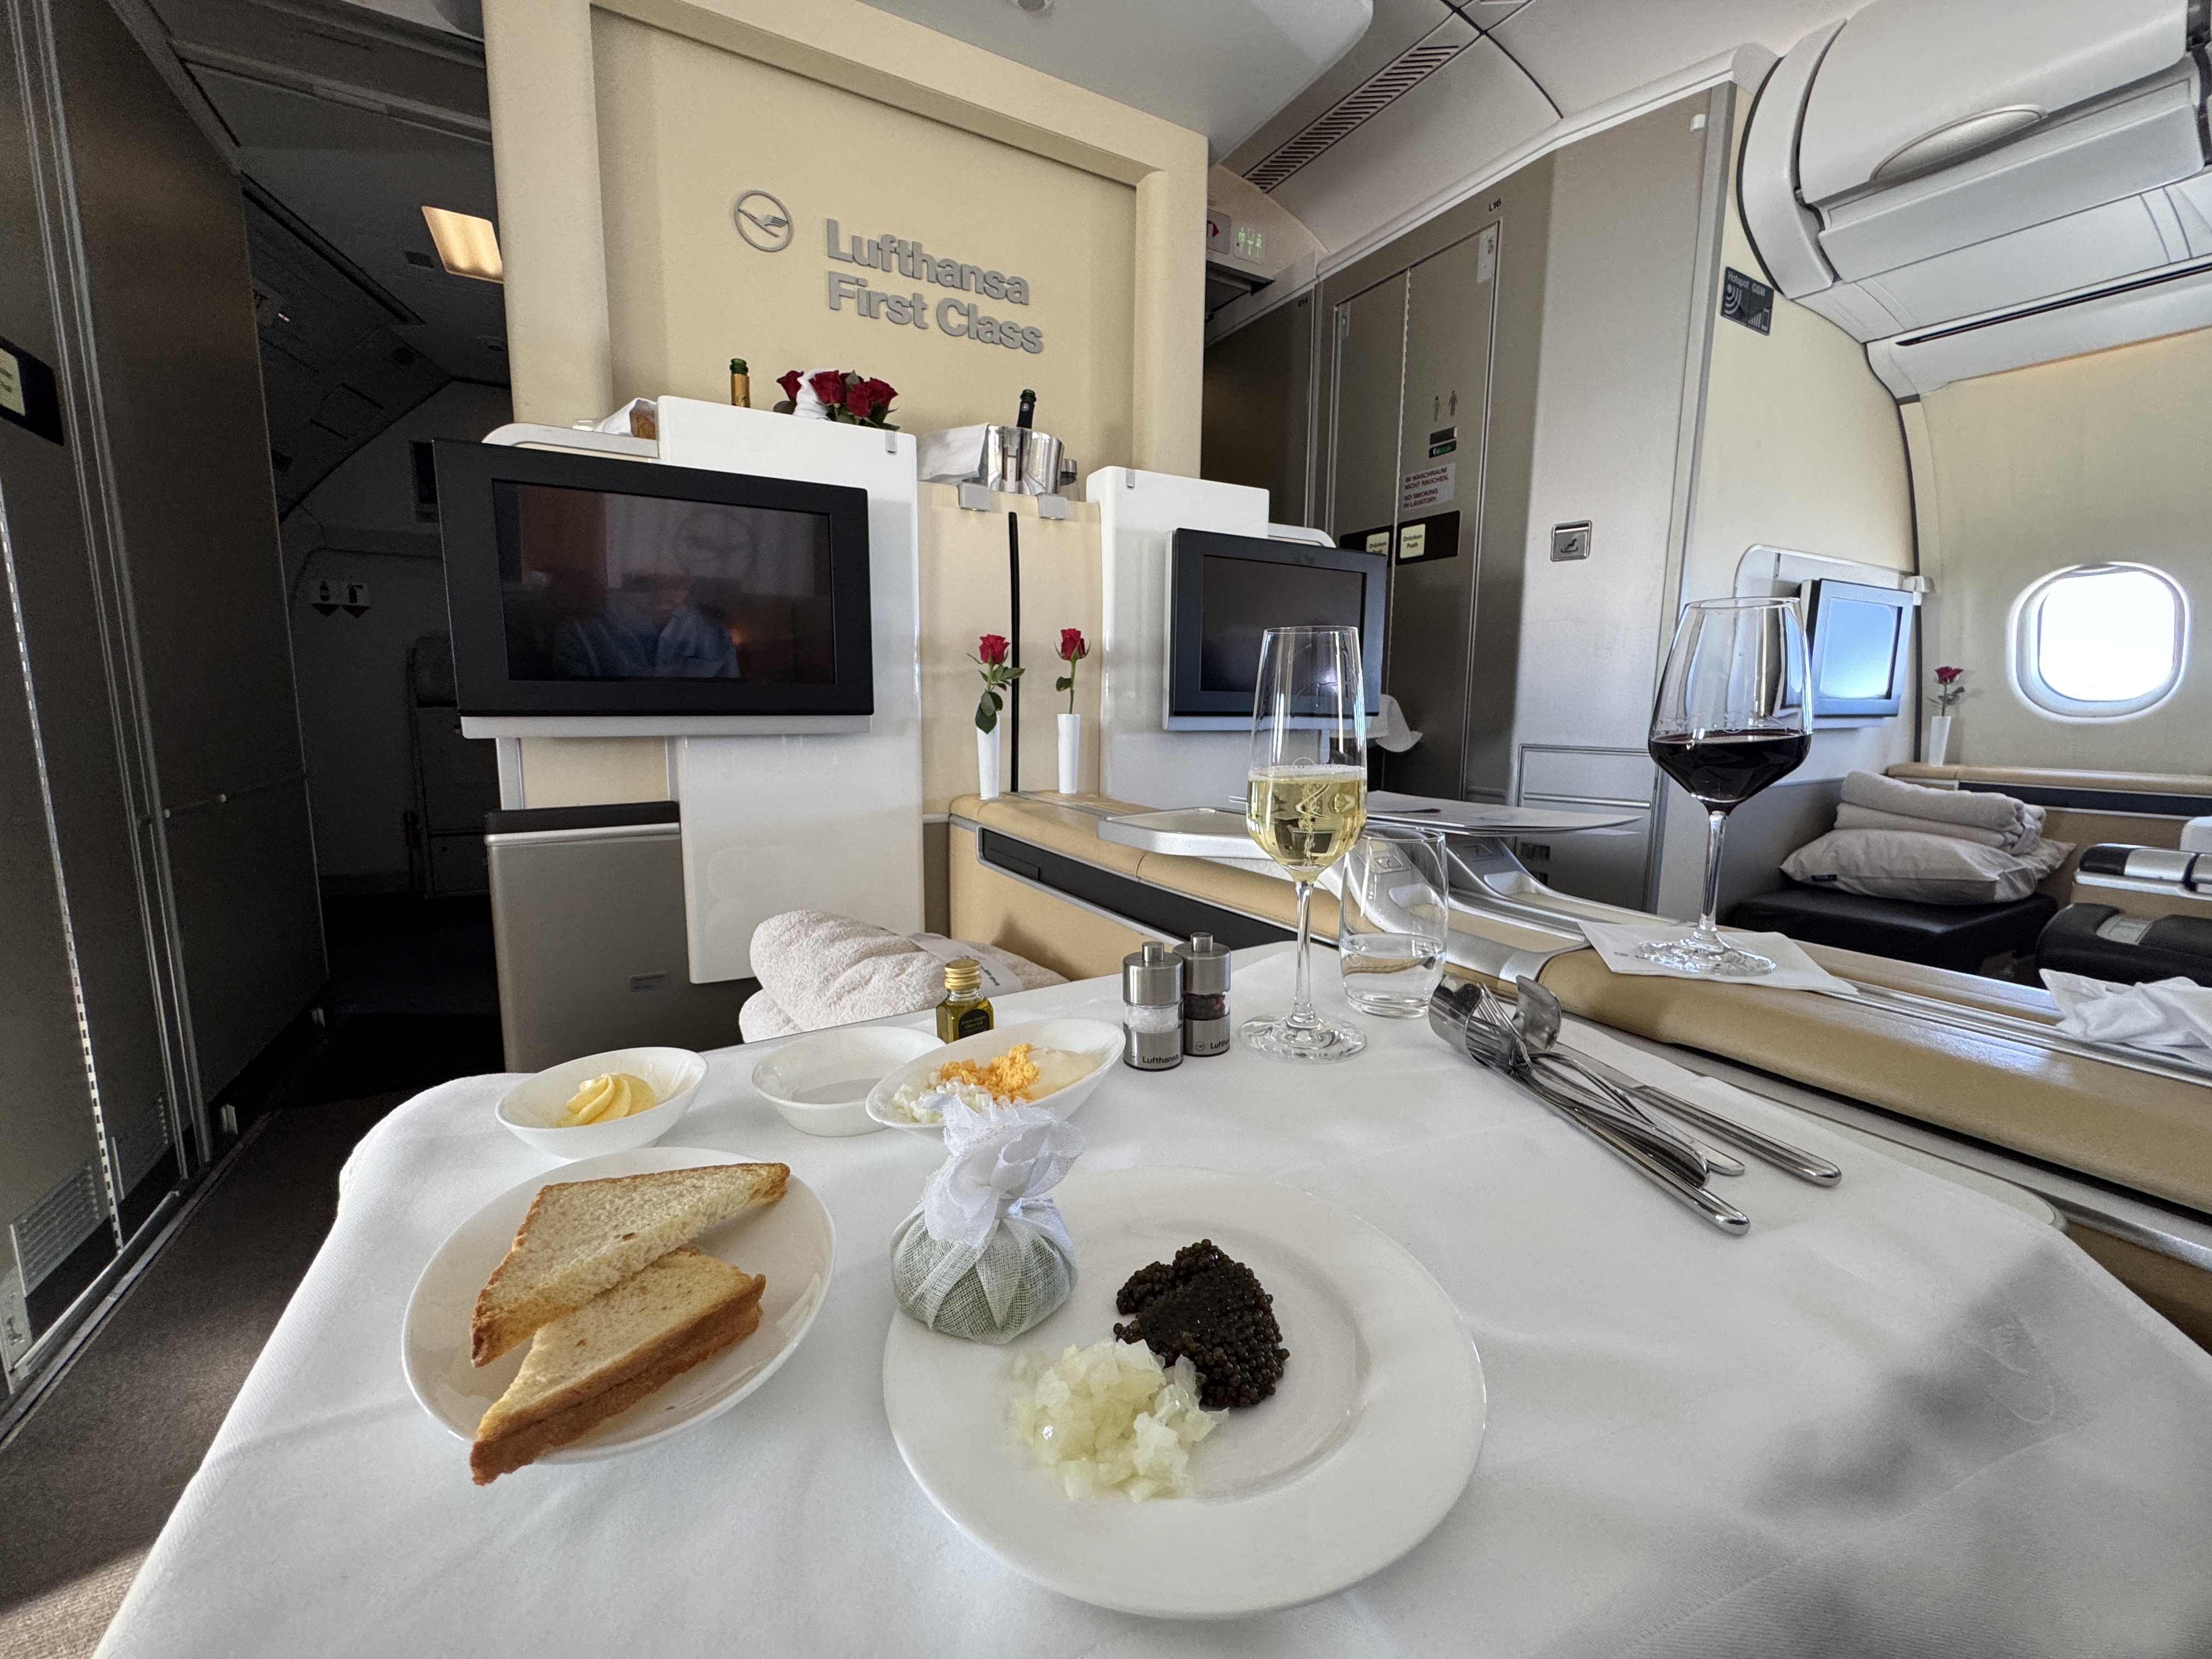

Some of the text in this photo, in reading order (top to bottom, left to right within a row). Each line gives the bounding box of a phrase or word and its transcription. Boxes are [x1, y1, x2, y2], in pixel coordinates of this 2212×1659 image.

[826, 218, 1030, 306] Lufthansa
[1728, 270, 1766, 297] Hotspot GSM
[828, 271, 1043, 354] First Class
[1412, 467, 1447, 481] WASCHRAUM
[1404, 481, 1420, 490] NICHT
[1413, 488, 1438, 499] SMOKING
[1142, 1054, 1179, 1064] Lufthansa
